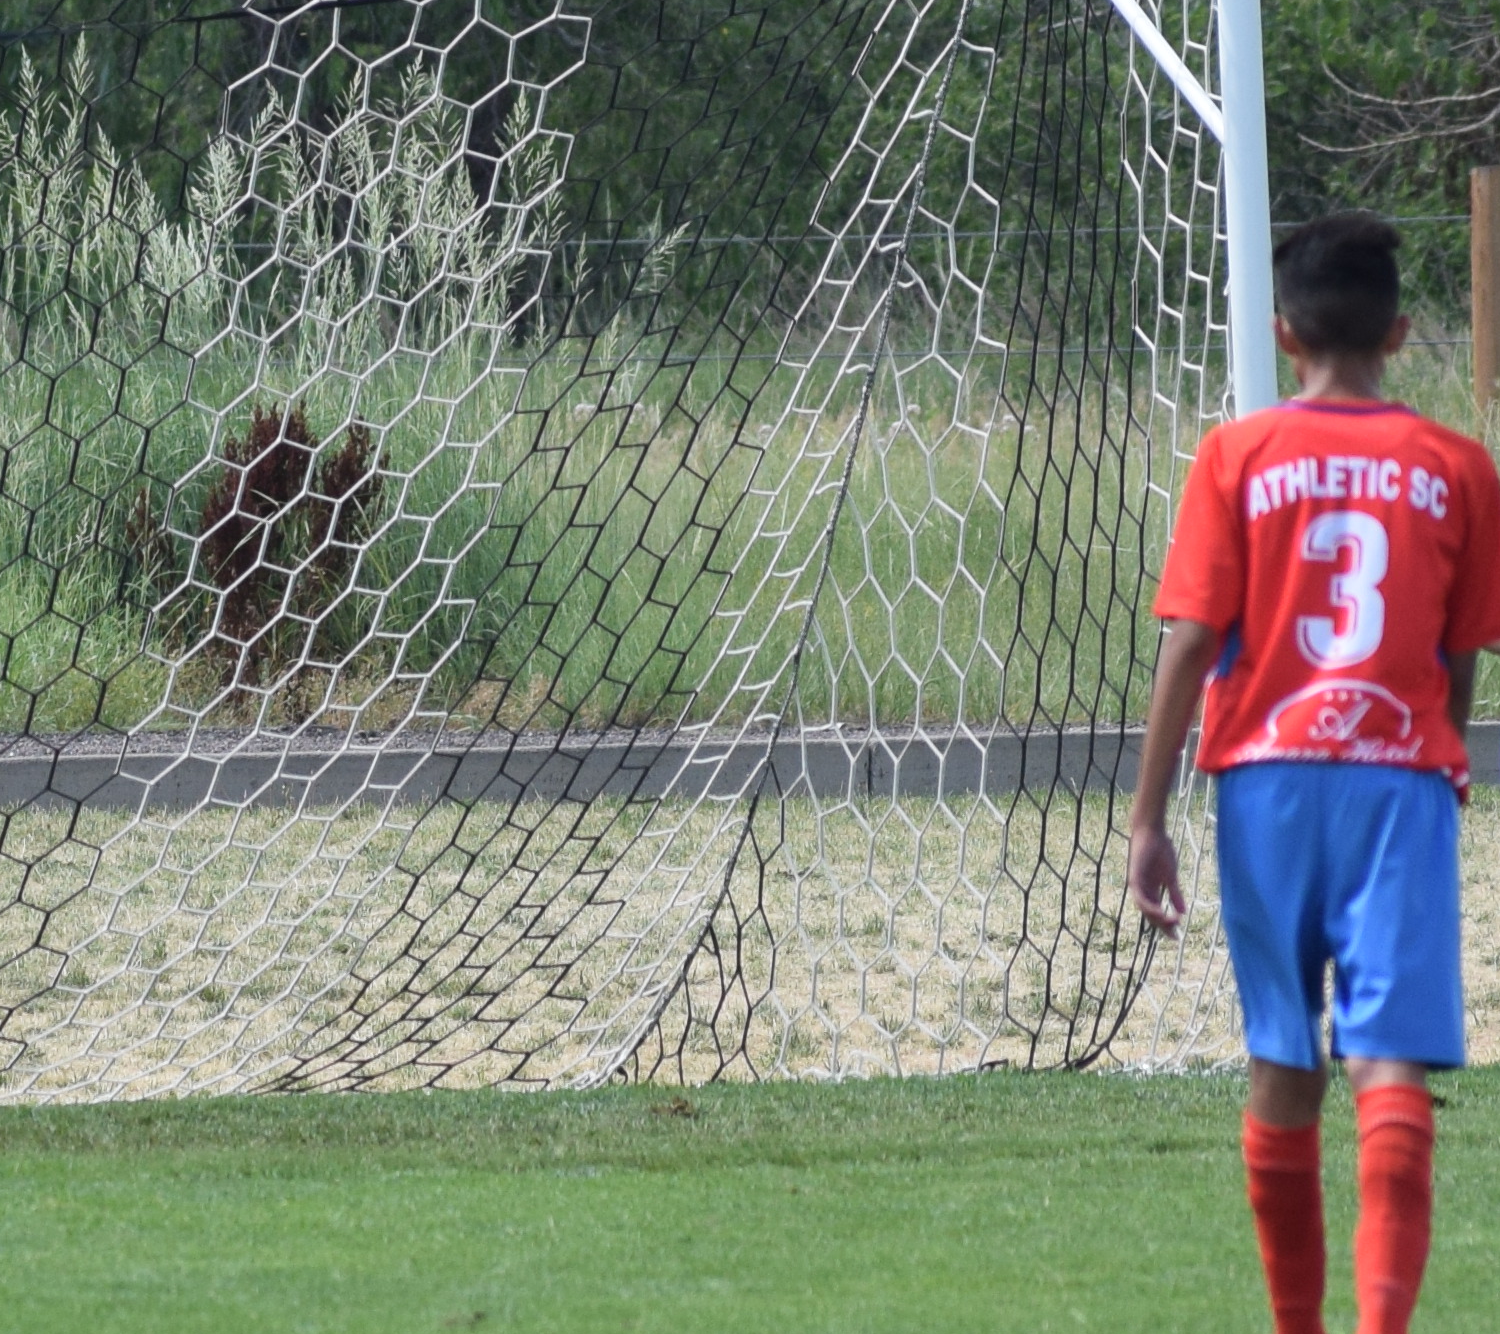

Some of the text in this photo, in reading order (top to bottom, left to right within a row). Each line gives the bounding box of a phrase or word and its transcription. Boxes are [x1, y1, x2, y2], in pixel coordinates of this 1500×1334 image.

[1248, 455, 1449, 520] ATHLETIC SC
[1296, 510, 1390, 670] 3
